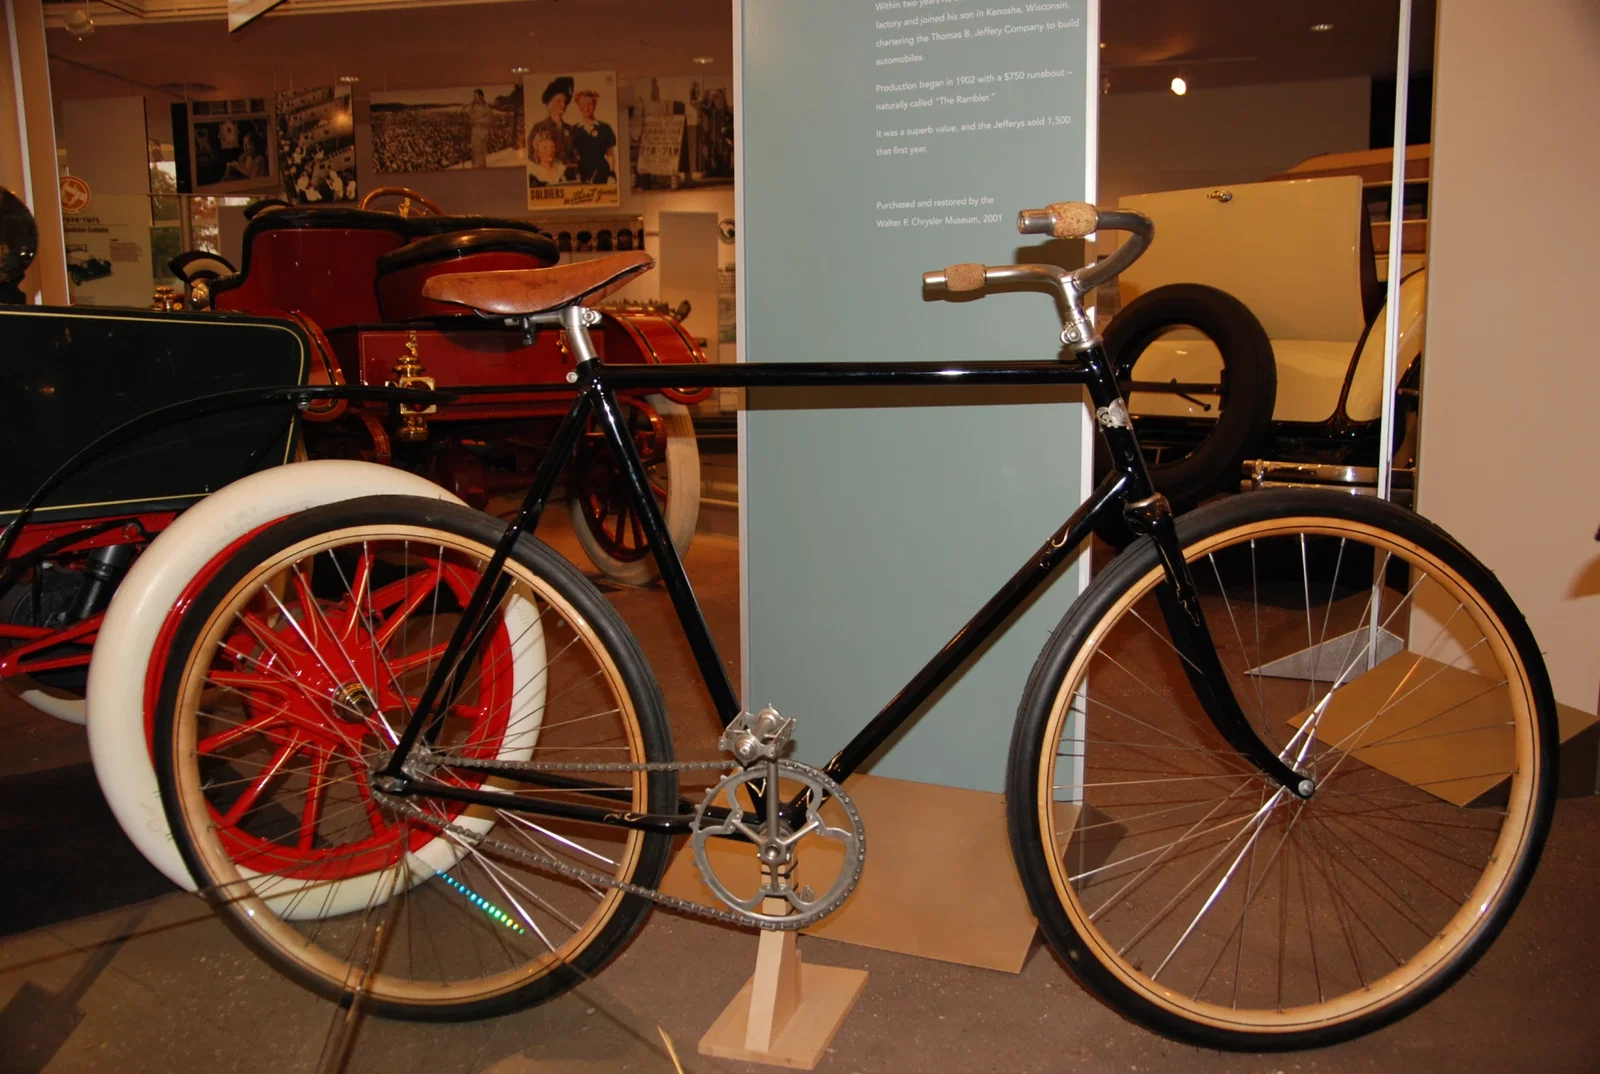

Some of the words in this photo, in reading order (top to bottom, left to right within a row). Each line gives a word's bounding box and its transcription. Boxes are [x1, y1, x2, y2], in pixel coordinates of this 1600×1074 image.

[875, 1, 900, 11] Within
[902, 0, 918, 8] two
[875, 19, 902, 29] factory
[904, 18, 919, 26] and
[919, 14, 945, 26] joined
[947, 12, 958, 21] his
[960, 12, 974, 20] son
[976, 10, 984, 18] in
[986, 5, 1024, 17] Kenosha,
[1025, 1, 1070, 12] Wisconsin,
[875, 36, 914, 47] chartering
[916, 33, 929, 43] the
[932, 32, 962, 41] Thomas
[964, 29, 972, 38] B.
[974, 27, 1002, 37] Jeffery
[1004, 23, 1044, 34] Company
[1057, 18, 1080, 28] build
[875, 54, 924, 65] automobiles.
[875, 82, 918, 92] Production
[919, 80, 944, 90] began
[946, 78, 953, 86] in
[956, 76, 975, 85] 1902
[977, 74, 995, 83] with
[997, 74, 1002, 82] a
[1004, 72, 1025, 81] $750
[1026, 69, 1065, 79] runabout
[875, 100, 908, 111] naturally
[910, 98, 933, 108] called
[876, 129, 882, 138] It
[884, 129, 898, 137] was
[907, 126, 934, 136] superb
[935, 125, 959, 133] value,
[961, 123, 976, 131] and
[978, 121, 991, 130] the
[993, 118, 1025, 129] Jefferys
[1027, 117, 1045, 126] sold
[1047, 115, 1071, 125] 1,500
[876, 146, 892, 156] that
[893, 145, 908, 154] first
[910, 145, 928, 155] year.
[530, 188, 564, 200] SOLDIERS
[563, 188, 596, 205] without
[876, 199, 915, 209] Purchased
[917, 198, 932, 207] and
[934, 197, 967, 206] restored
[969, 196, 979, 207] by
[980, 196, 994, 204] the
[876, 217, 901, 227] Walter
[903, 217, 910, 226] P.
[911, 216, 942, 227] Chrysler
[944, 215, 981, 225] Museum,
[983, 214, 1003, 223] 2001
